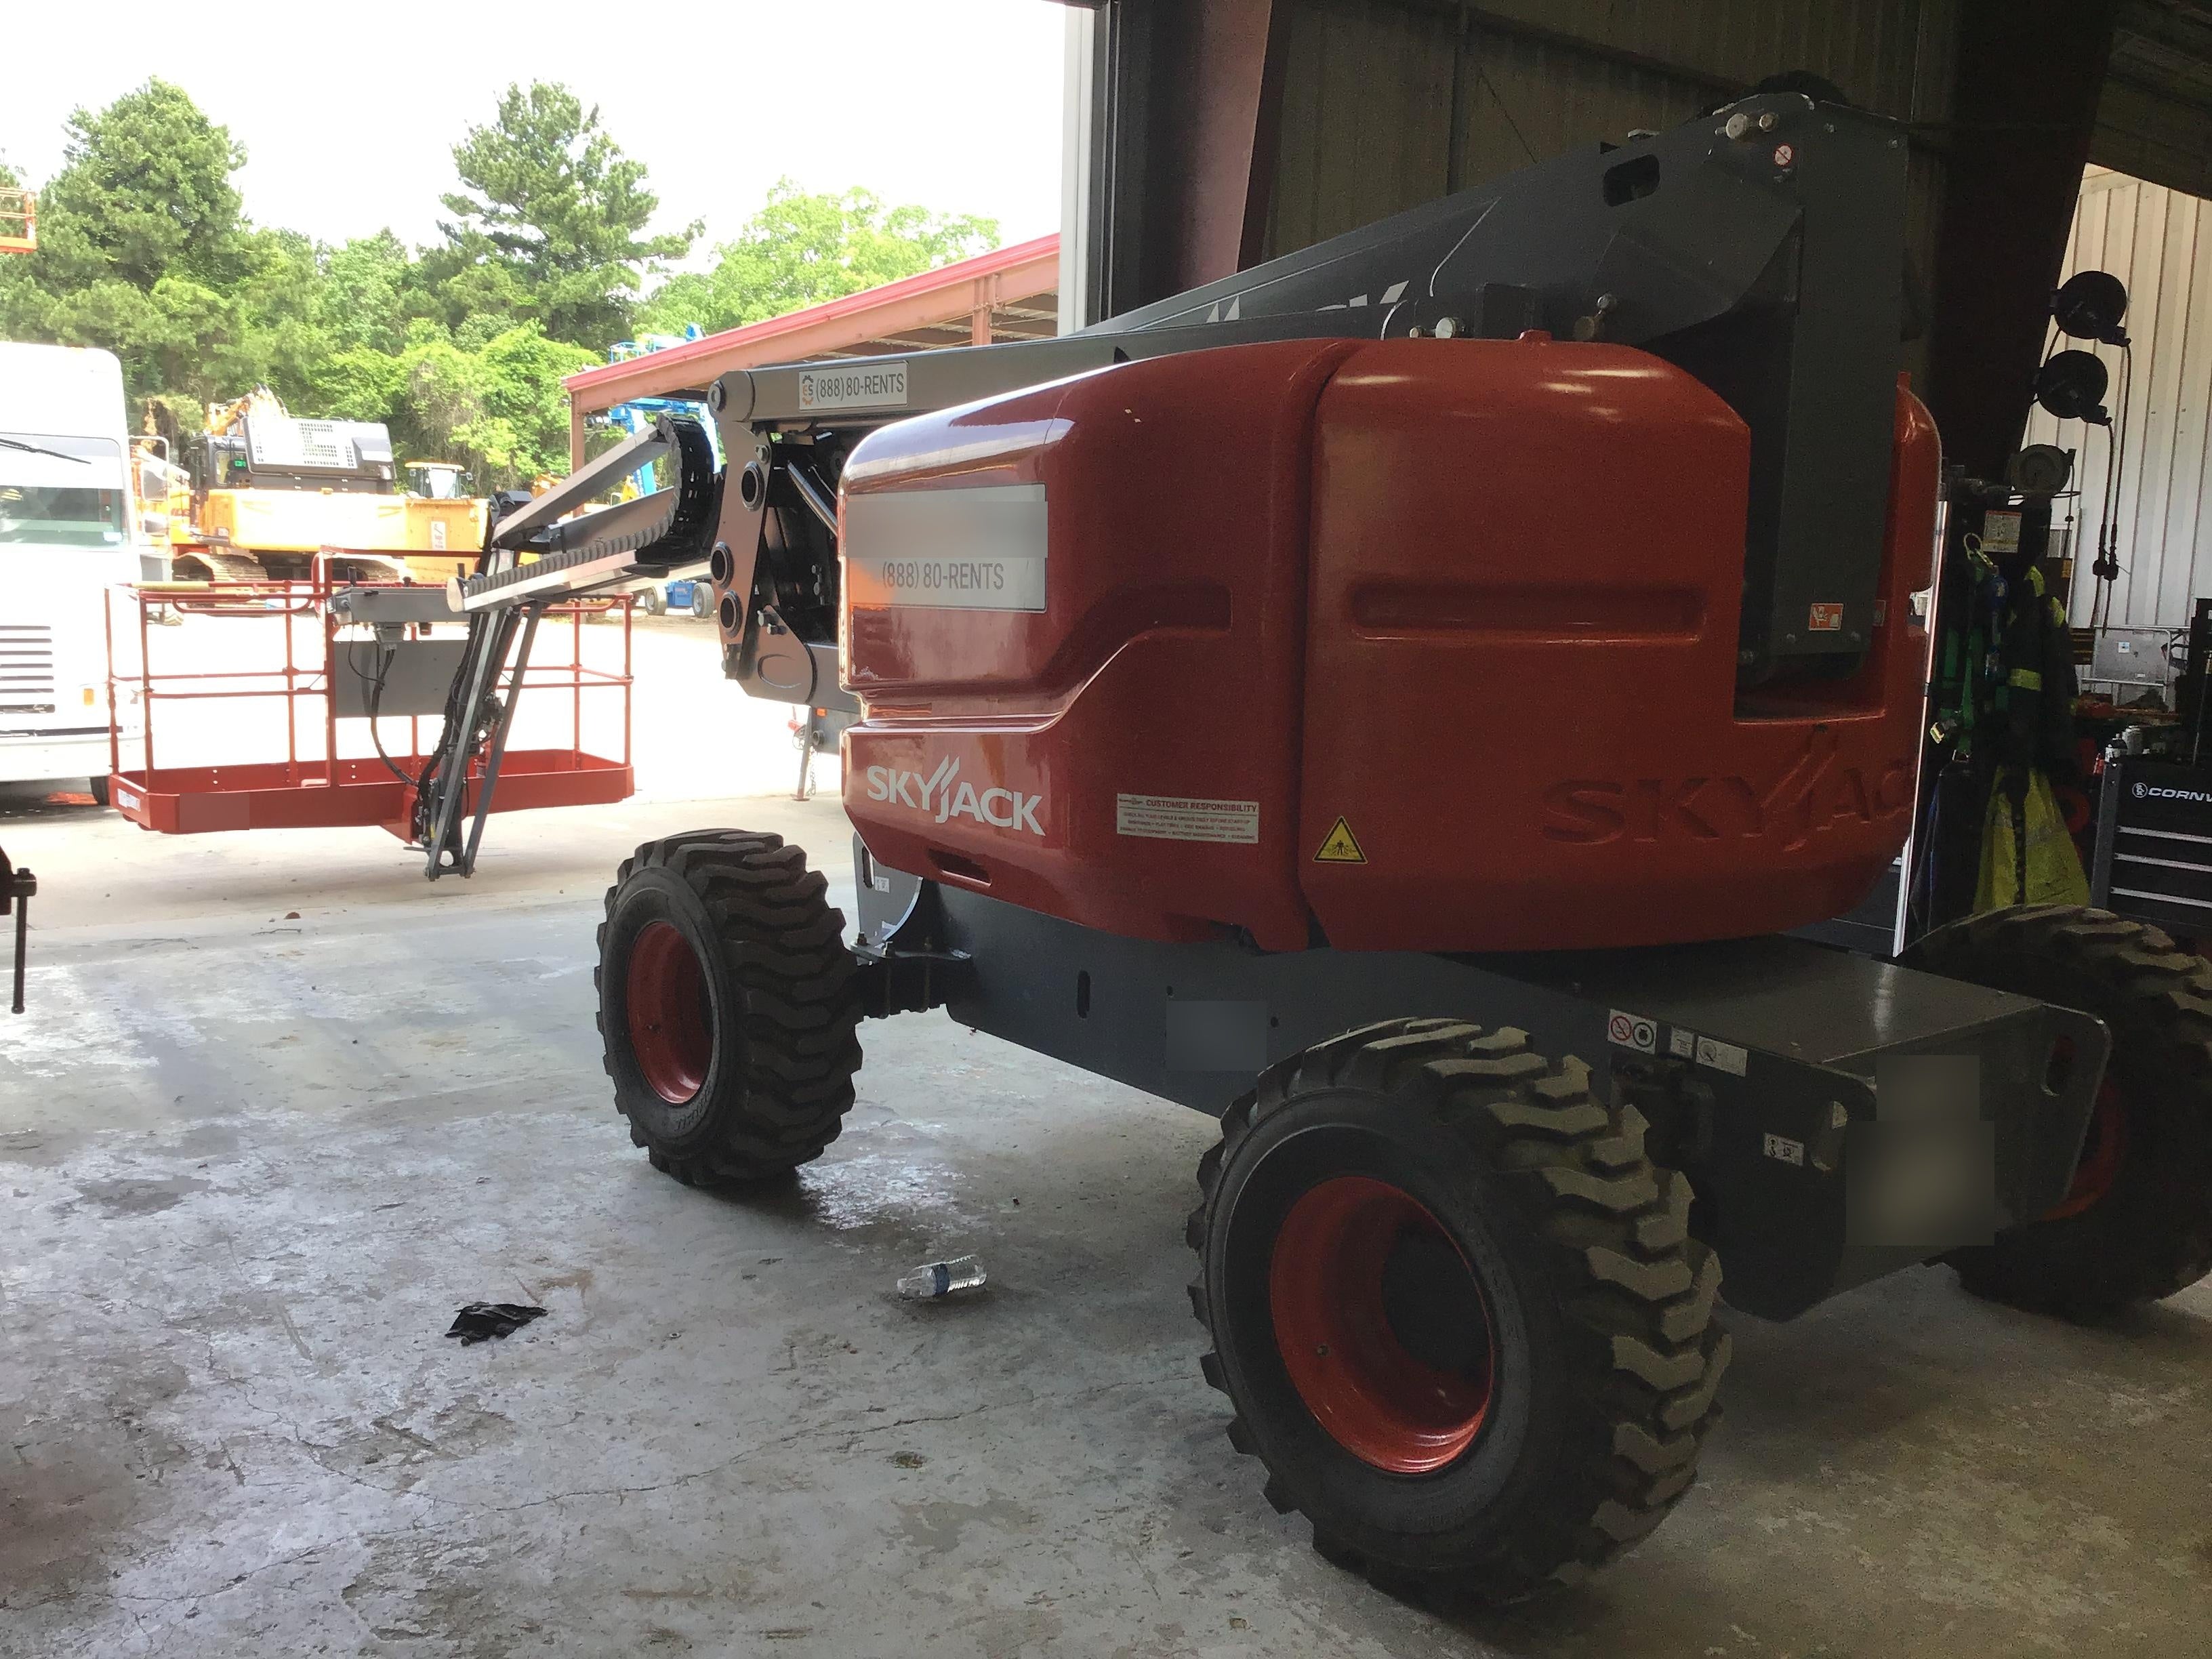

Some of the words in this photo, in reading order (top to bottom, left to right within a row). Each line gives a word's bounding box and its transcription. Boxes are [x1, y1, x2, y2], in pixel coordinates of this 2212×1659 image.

[846, 373, 905, 396] 80-RENTS
[882, 561, 919, 590] (888)
[924, 562, 1004, 590] 80-RENTS
[867, 754, 1046, 837] SKYJACK
[1145, 799, 1188, 810] CUSTOMER
[1190, 802, 1257, 813] RESPONSIBILITY
